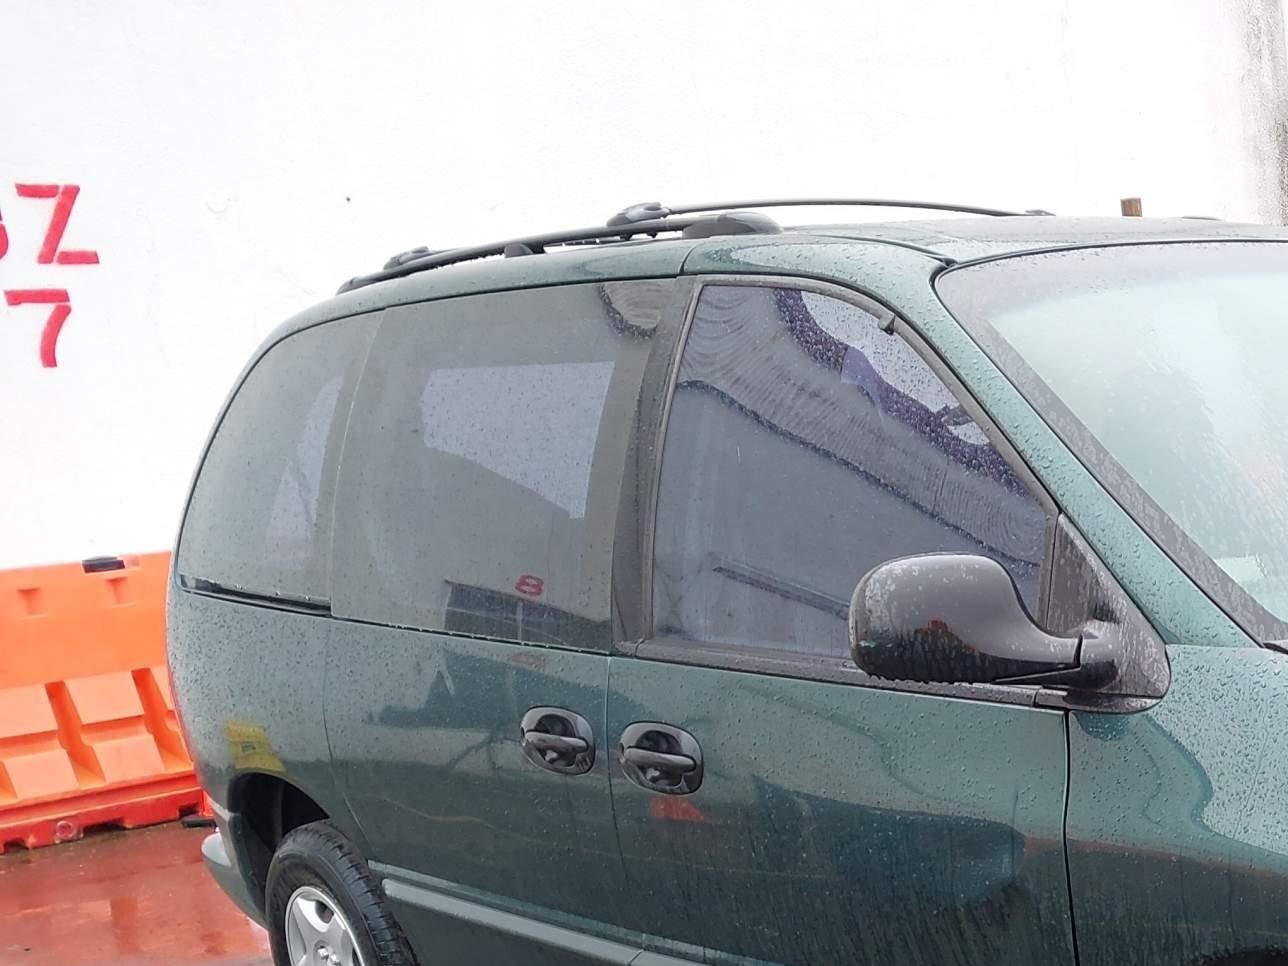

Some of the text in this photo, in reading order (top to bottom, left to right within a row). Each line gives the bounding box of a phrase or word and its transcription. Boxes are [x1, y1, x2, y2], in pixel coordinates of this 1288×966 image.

[0, 183, 100, 264] Z
[4, 288, 71, 368] 7
[515, 575, 544, 596] 8
